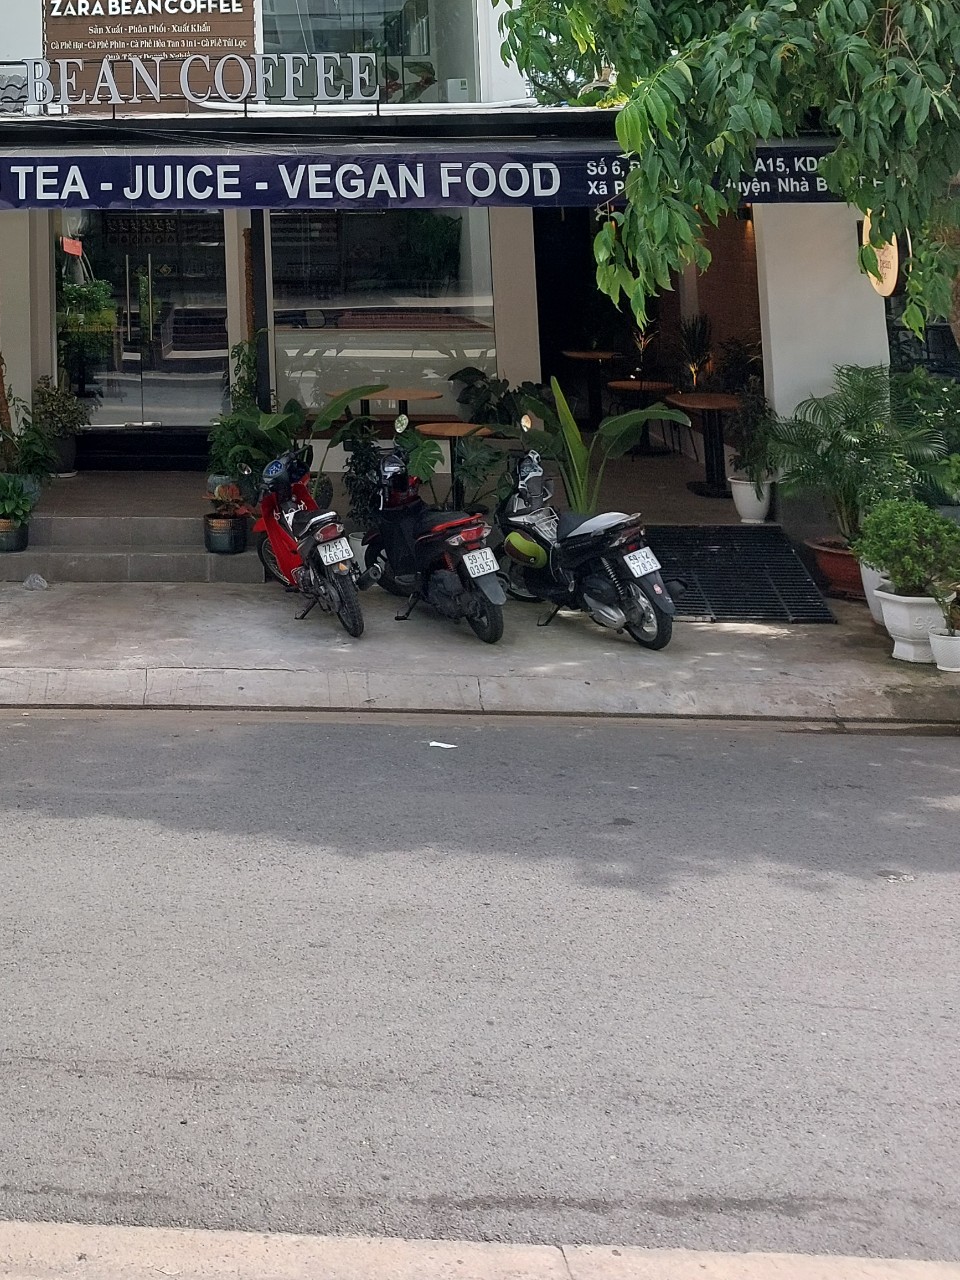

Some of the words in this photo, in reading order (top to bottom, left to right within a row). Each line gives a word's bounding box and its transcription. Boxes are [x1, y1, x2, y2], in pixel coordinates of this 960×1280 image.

[88, 24, 104, 34] Sản
[105, 23, 123, 34] Xuất
[128, 25, 147, 34] Phân
[171, 22, 189, 32] Xuất
[51, 41, 59, 49] Cà
[234, 39, 247, 48] Lọc
[22, 56, 165, 106] BEAN
[179, 52, 380, 104] COFFEE
[586, 157, 608, 175] Số
[612, 160, 625, 177] 6,
[754, 157, 790, 175] A15,
[10, 165, 89, 200] TEA
[123, 164, 242, 200] JUICE
[278, 163, 426, 199] VEGAN
[440, 162, 561, 198] FOOD
[588, 180, 608, 195] Xã
[778, 177, 810, 192] Nhà
[468, 551, 490, 564] 59-T2
[470, 560, 495, 575] 039.57
